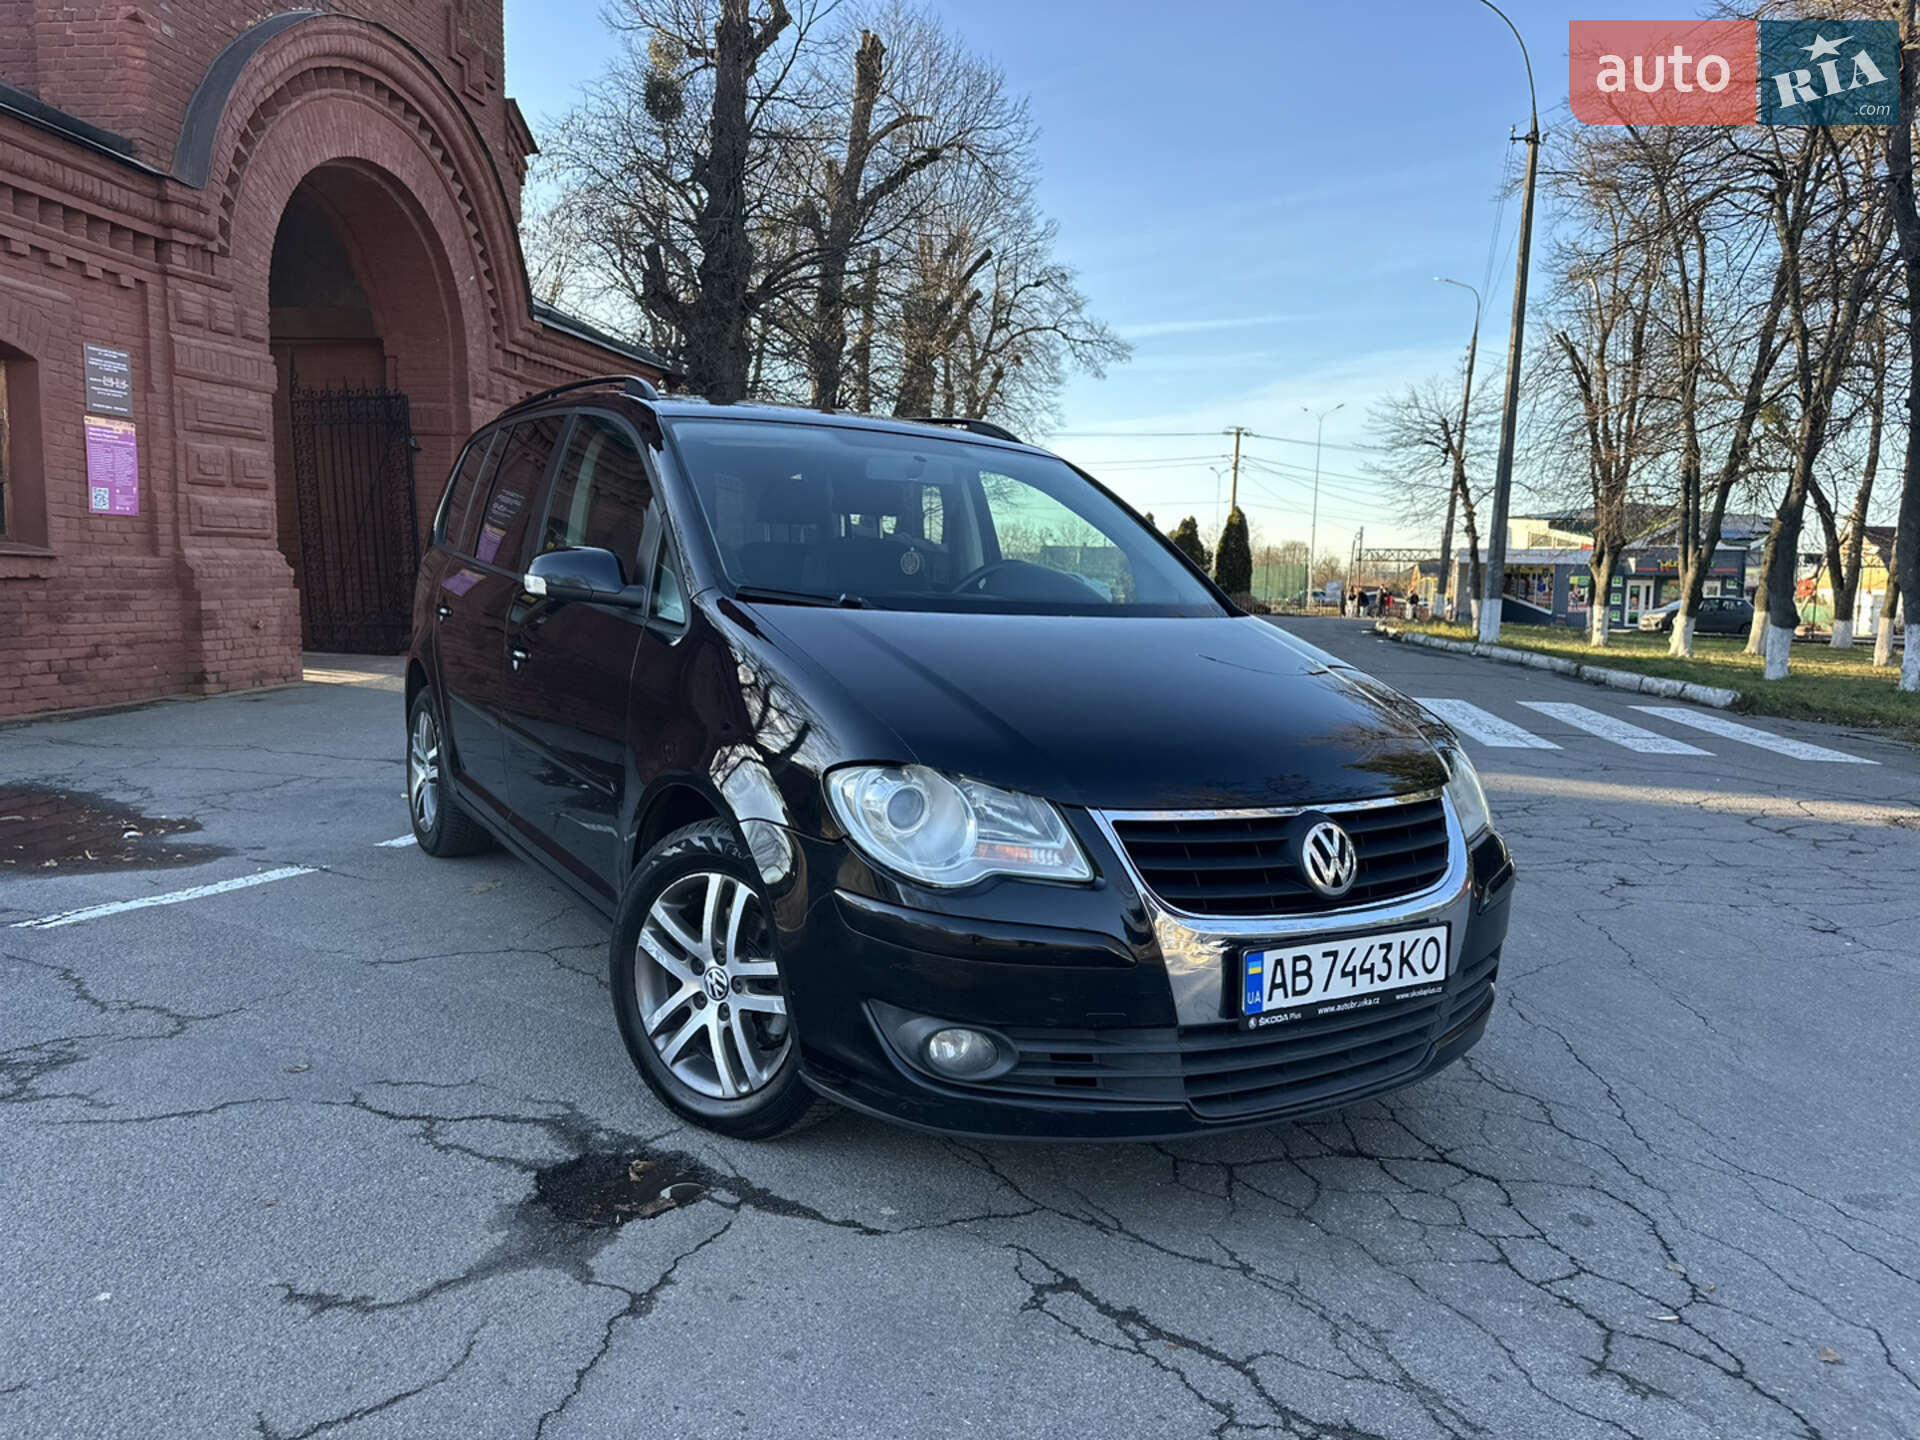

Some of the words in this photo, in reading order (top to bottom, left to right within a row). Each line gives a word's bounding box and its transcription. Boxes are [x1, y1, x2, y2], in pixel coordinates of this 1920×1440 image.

[1267, 954, 1313, 1002] AB
[1321, 942, 1393, 993] 7443
[1398, 935, 1441, 980] KO
[1247, 990, 1262, 1005] UA
